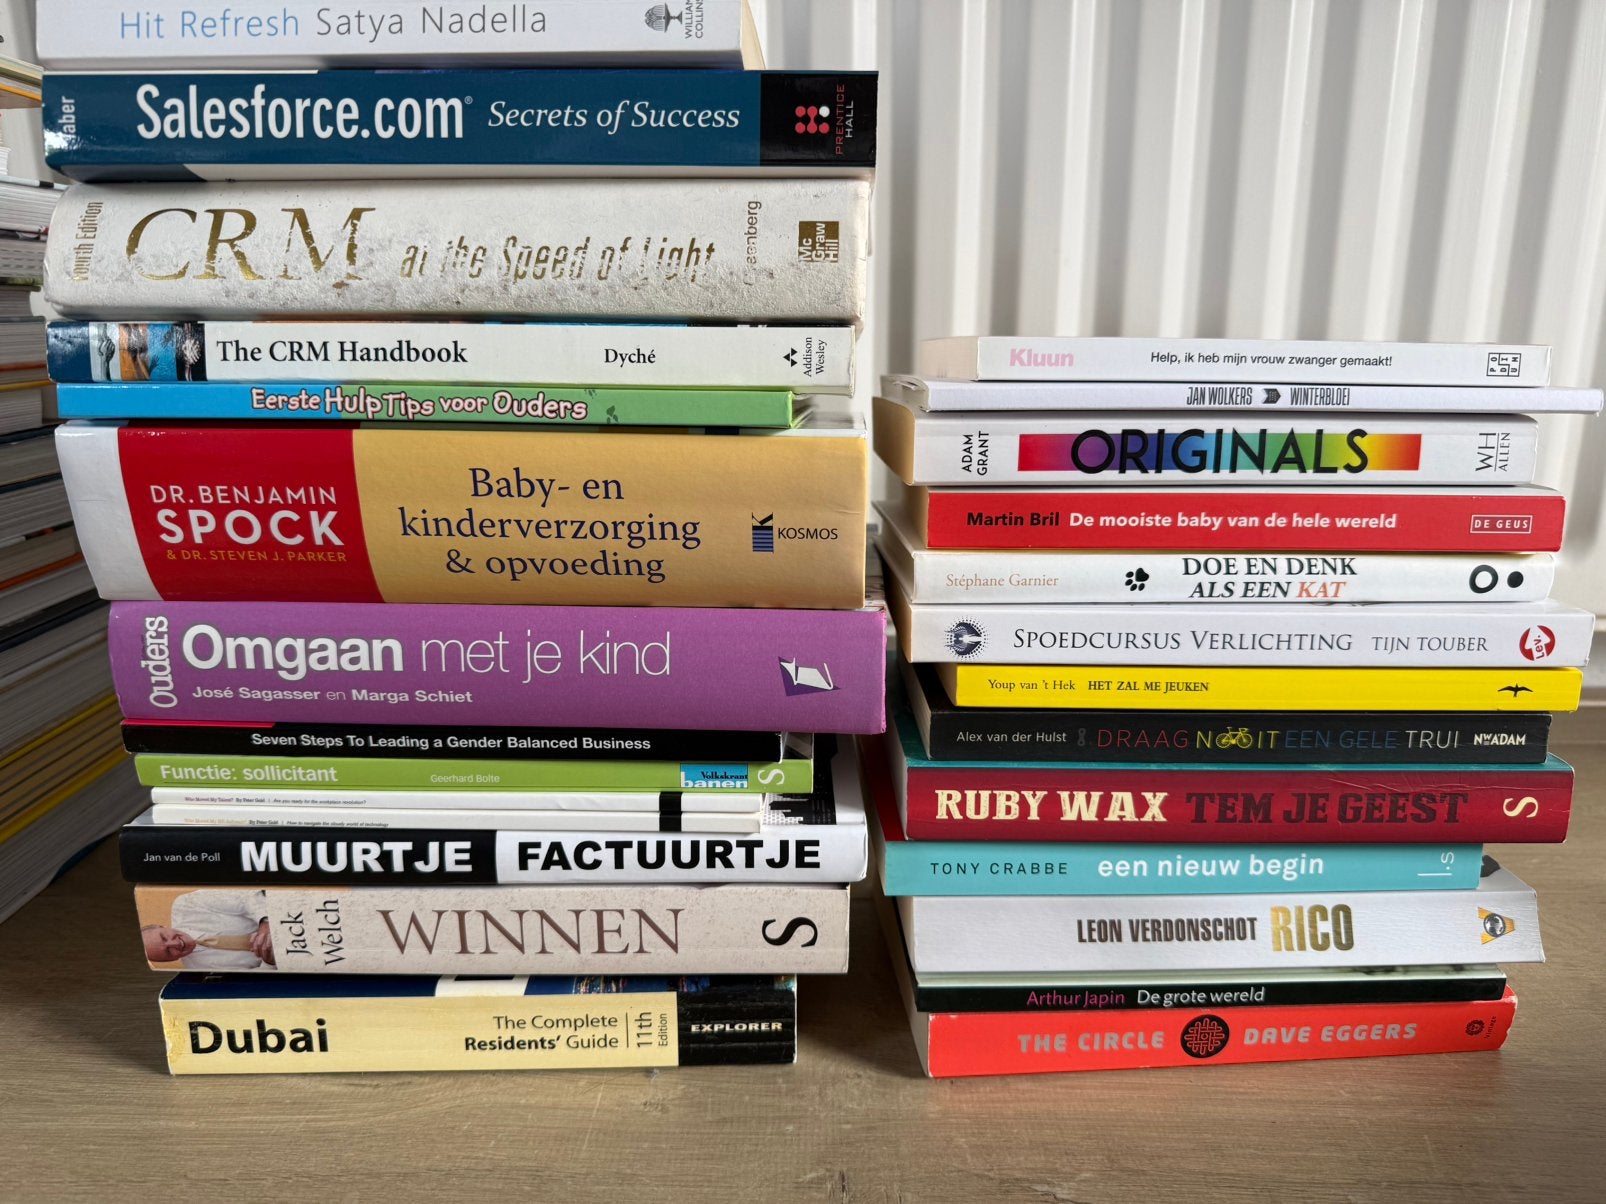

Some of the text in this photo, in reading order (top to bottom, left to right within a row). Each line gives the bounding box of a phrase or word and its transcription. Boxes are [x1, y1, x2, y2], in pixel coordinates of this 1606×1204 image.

[120, 5, 546, 42] Hit Refresh Satya Nadella
[695, 0, 704, 39] COLLIN
[58, 95, 76, 138] aber
[488, 99, 740, 135] Secrets of Success
[836, 84, 845, 155] PRENTICE
[845, 100, 854, 138] HALL
[75, 201, 104, 240] Edition
[125, 207, 376, 282] CRM
[812, 222, 826, 261] Graw
[825, 239, 839, 261] Hill
[217, 340, 468, 364] The CRM Handbook
[604, 347, 656, 368] Dyché
[803, 336, 813, 378] Addison
[815, 339, 827, 375] Wesley
[1009, 348, 1074, 367] Kluun
[1150, 352, 1393, 368] Help, heb mijn vrouw zwanger gemaakt!
[250, 386, 588, 421] Eerste voor Ouders
[1186, 387, 1207, 405] JAN
[1209, 387, 1253, 405] WOLKERS
[1290, 387, 1350, 406] WINTERBLOEI
[961, 434, 974, 473] ADAM
[977, 430, 990, 476] GRANT
[1070, 427, 1369, 475] ORIGINALS
[1499, 432, 1510, 471] ALLEN
[150, 485, 337, 505] DR. BENJAMIN
[469, 467, 624, 508] Baby- en
[156, 508, 345, 546] SPOCK
[398, 507, 701, 550] kinderverzorging
[778, 527, 838, 540] KOSMOS
[967, 512, 1396, 530] Martin Bril De mooiste baby van de hele wereld
[1475, 519, 1529, 529] DE GEUS
[210, 550, 347, 562] STEVEN PARKER
[445, 550, 666, 584] & opvoeding
[1182, 557, 1358, 576] DOE EN DENK
[946, 573, 1059, 589] Stéphane Garnier
[1189, 581, 1346, 598] ALS EEN KAT
[182, 624, 671, 683] Omgaan met je kind
[1013, 628, 1489, 654] SPOEDCURSUS VERLICHTING TIJN TOUBER
[141, 616, 178, 708] Ouders
[192, 686, 473, 704] José Sagasser Marga Schiet
[988, 679, 1209, 693] Youp Hek HET ZAL ME JEUKEN
[251, 733, 651, 750] Seven Steps To Leading Gender Balanced Business
[956, 731, 983, 742] Alex
[986, 734, 1008, 742] van
[1011, 731, 1032, 742] der
[1036, 731, 1067, 742] Hulst
[1097, 729, 1189, 749] DRAAG
[1284, 730, 1330, 748] EEN
[1339, 730, 1398, 748] GELE
[1405, 730, 1459, 749] TRUI
[160, 763, 338, 783] Functie: sollicitant
[430, 773, 472, 784] Geerhard
[680, 771, 748, 788] banen
[935, 789, 1469, 824] RUBY WAX TEM JE GEEST
[143, 852, 221, 862] Jan Poll
[241, 839, 821, 872] MUURTJE FACTUURTJE
[931, 854, 1324, 881] TONY CRABBE een nieuw begin
[280, 911, 313, 957] Jack
[315, 898, 346, 966] Welch
[376, 908, 685, 955] WINNEN
[761, 916, 818, 947] S
[1077, 903, 1354, 951] LEON VERDONSCHOT RICO
[1026, 986, 1265, 1008] Arthur Japin De grote wereld
[188, 1018, 329, 1054] Dubai
[493, 1014, 618, 1032] The Complete
[637, 1011, 652, 1048] 11th
[657, 1013, 668, 1047] Edition
[690, 1021, 783, 1032] EXPLORER
[1017, 1022, 1418, 1054] THE CIRCLE DAVE EGGERS
[566, 1034, 619, 1050] Guide
